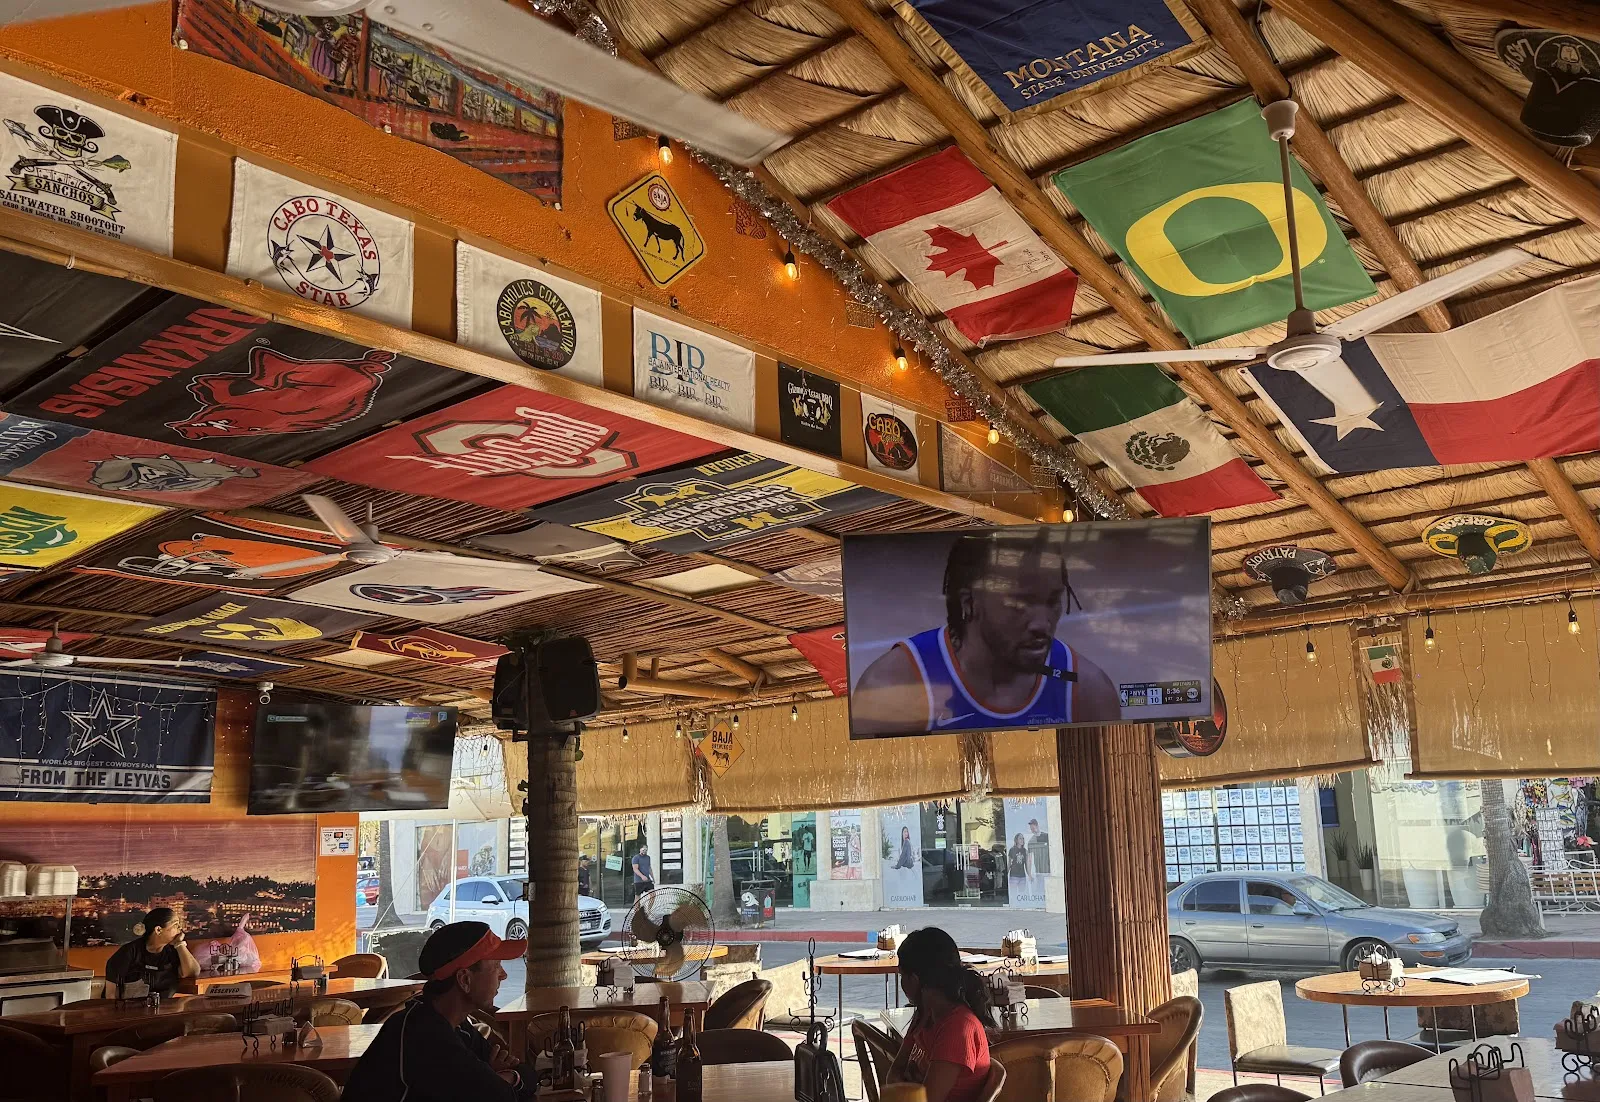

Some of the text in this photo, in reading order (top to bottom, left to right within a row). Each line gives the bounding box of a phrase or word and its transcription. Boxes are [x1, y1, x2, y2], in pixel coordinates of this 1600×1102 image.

[1003, 23, 1153, 89] MONTANA
[1020, 74, 1066, 101] STATE
[1068, 40, 1161, 80] UNIVERSITY
[2, 200, 19, 210] CABO
[21, 206, 33, 214] SAN
[34, 178, 95, 205] SANCHOS
[0, 189, 126, 234] SALTWATER SHOOTOUT
[273, 198, 377, 261] CABO TEXAS
[295, 281, 351, 307] STAR
[499, 281, 575, 355] CABOHOLICS CONVENTION
[38, 308, 269, 418] ARKANSAS
[646, 329, 716, 392] BIR
[515, 406, 609, 456] OHIO
[868, 413, 901, 438] CABO
[385, 438, 578, 476] STATE
[694, 451, 769, 478] ICHIGAN
[633, 483, 794, 527] CHAMPIONS
[669, 493, 798, 531] NATIONAL
[1436, 516, 1496, 532] OREGON
[1246, 547, 1297, 569] PATRIOTS
[712, 730, 733, 744] BAJA
[20, 768, 171, 789] FROM THE LEYVAS
[73, 759, 104, 767] BIGGEST
[105, 760, 140, 768] COWBOYS
